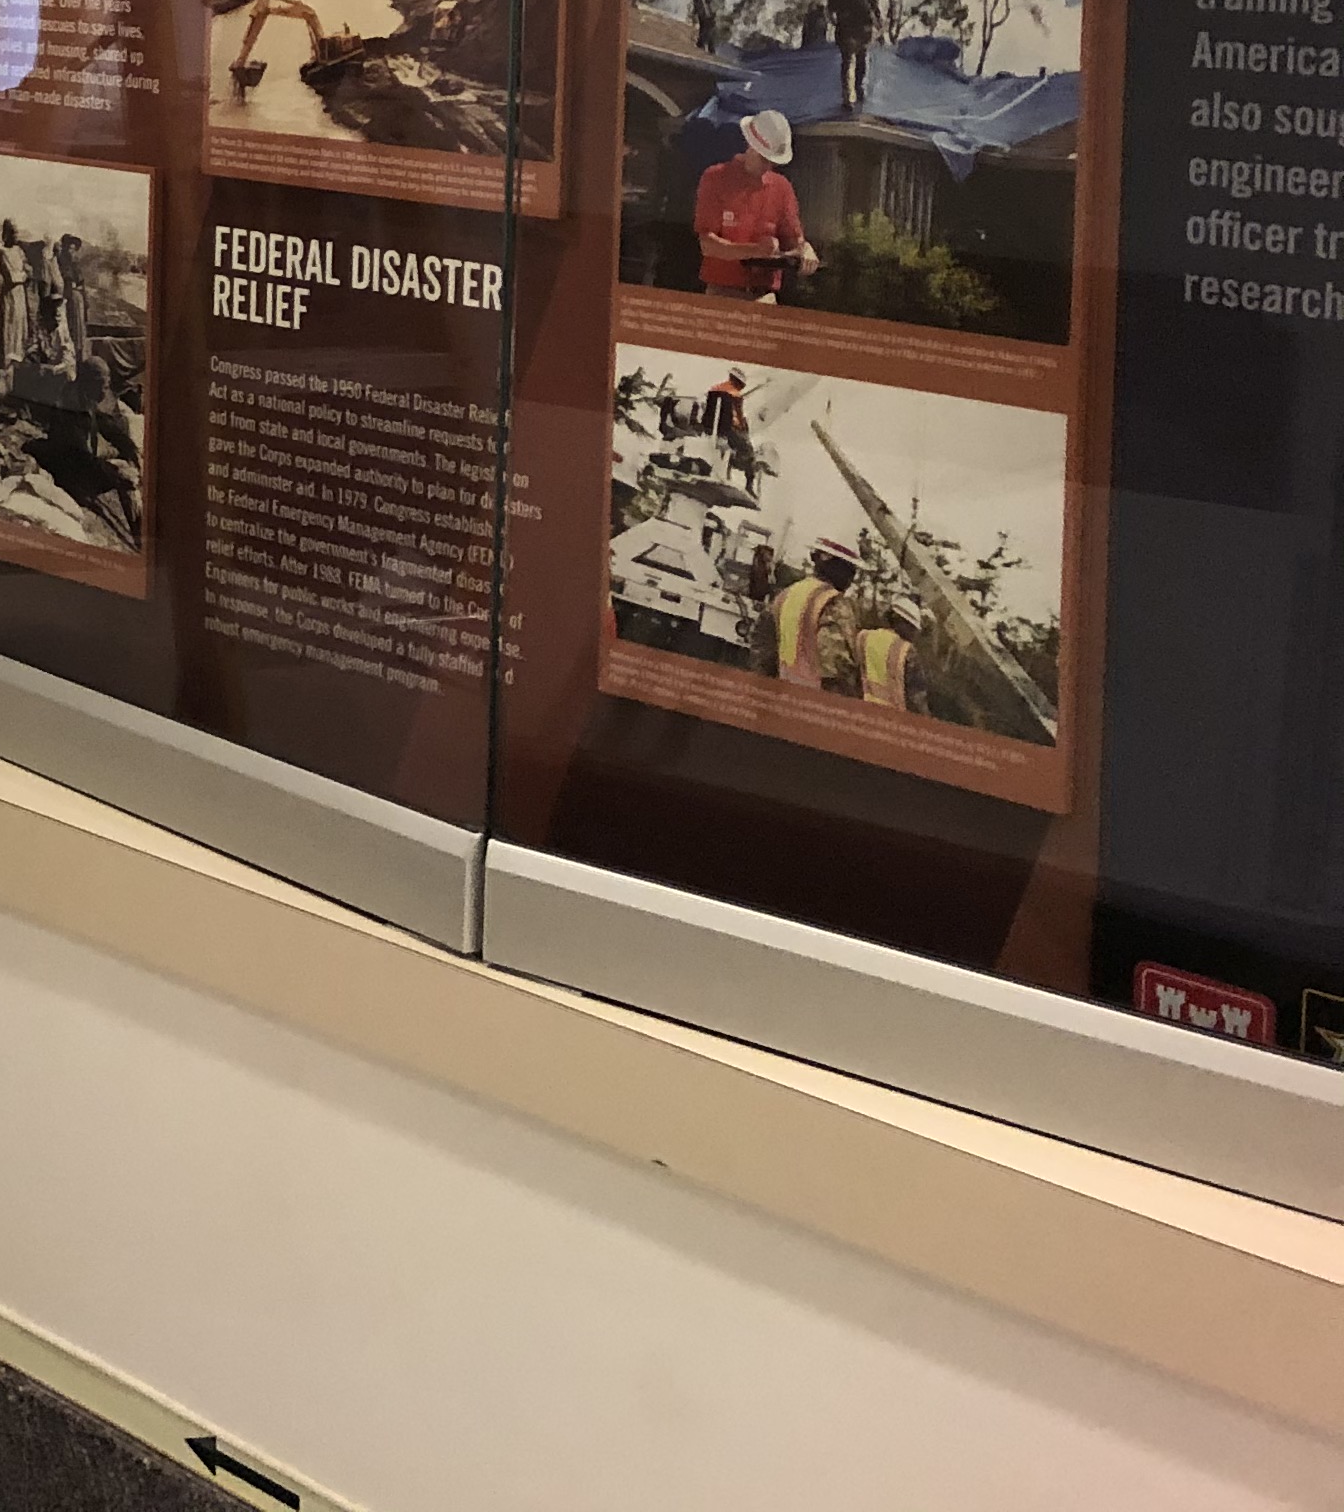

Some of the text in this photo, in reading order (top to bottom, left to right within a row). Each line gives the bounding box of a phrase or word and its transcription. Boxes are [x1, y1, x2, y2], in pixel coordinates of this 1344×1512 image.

[1189, 91, 1262, 131] also
[1185, 209, 1302, 255] officer
[214, 224, 503, 311] FEDERAL DISASTER
[213, 274, 311, 330] RELIEF
[208, 383, 482, 447] Act national policy requests
[211, 356, 464, 418] Congress passed Federal Disaster
[259, 446, 352, 480] Corps expanded
[228, 492, 464, 563] Federal Emergency Management Agency
